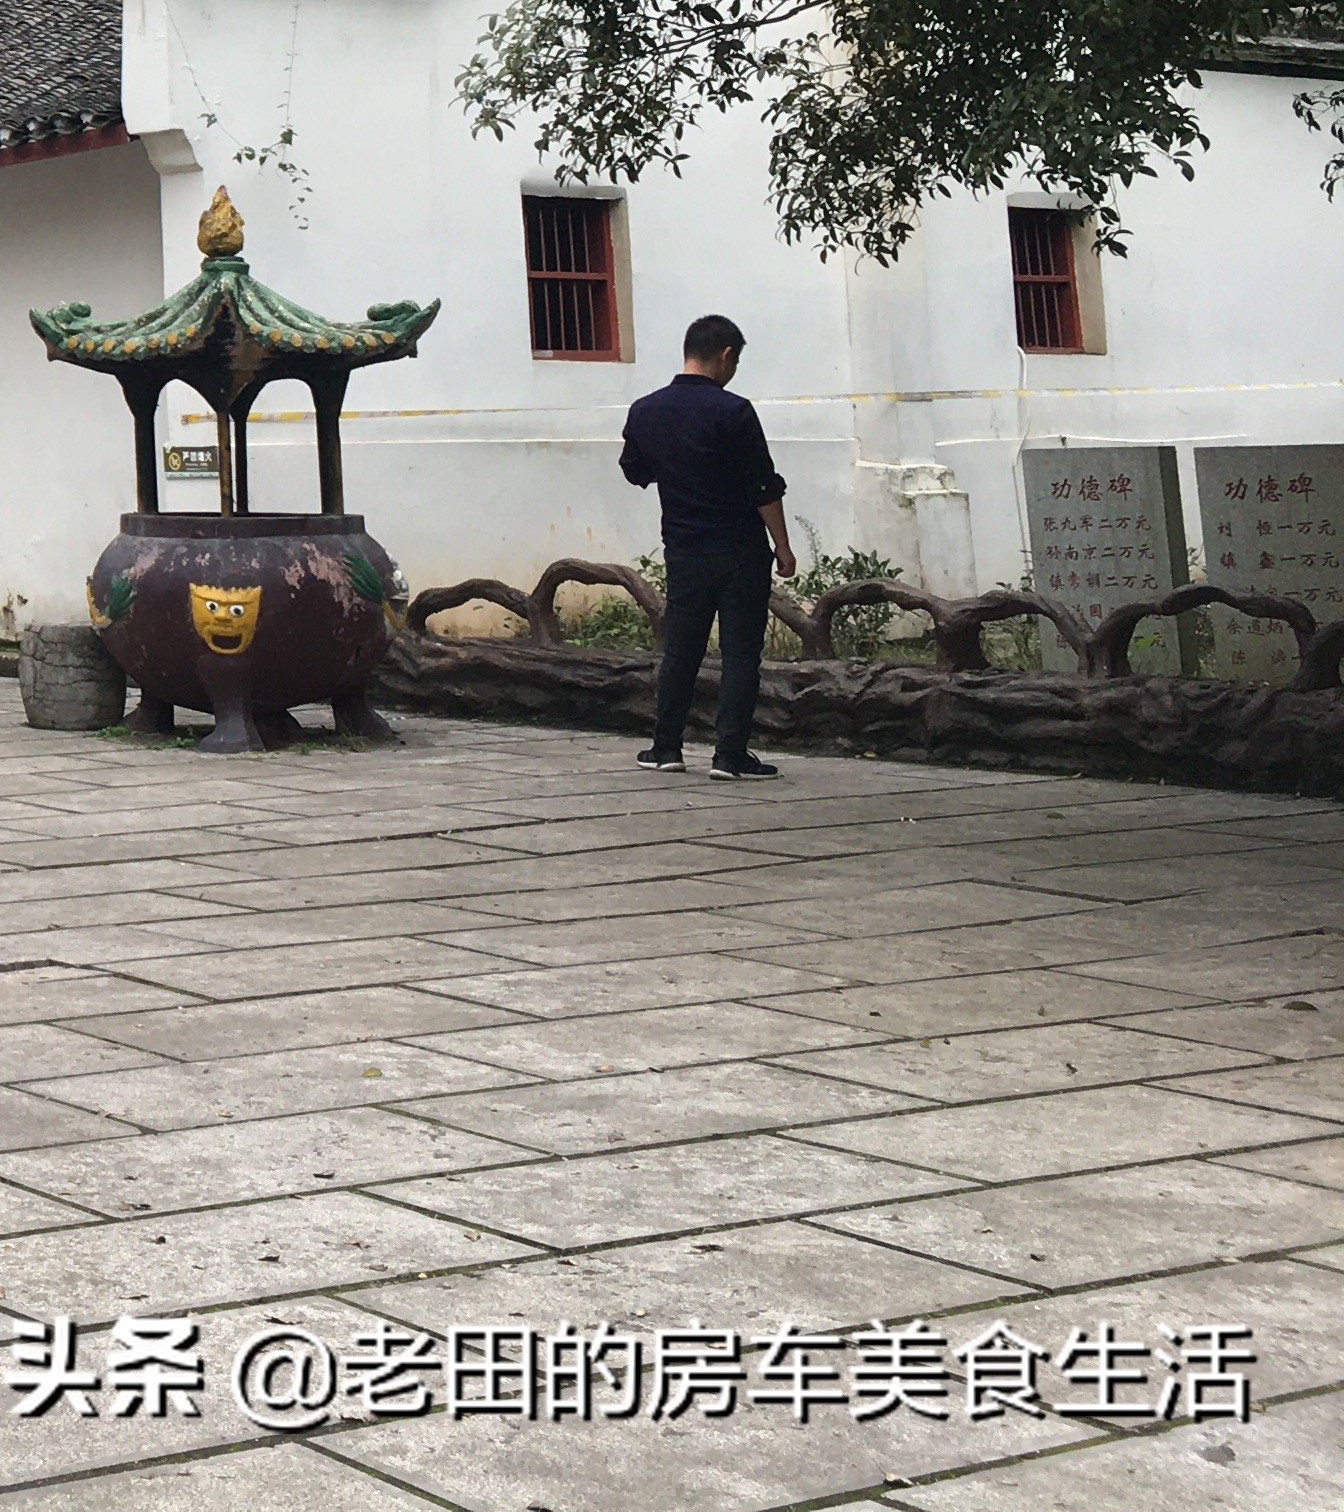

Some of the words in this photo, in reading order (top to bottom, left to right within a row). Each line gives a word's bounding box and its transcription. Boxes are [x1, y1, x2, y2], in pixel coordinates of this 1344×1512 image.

[1050, 473, 1133, 502] 功德碑
[1224, 472, 1317, 504] 功德碑
